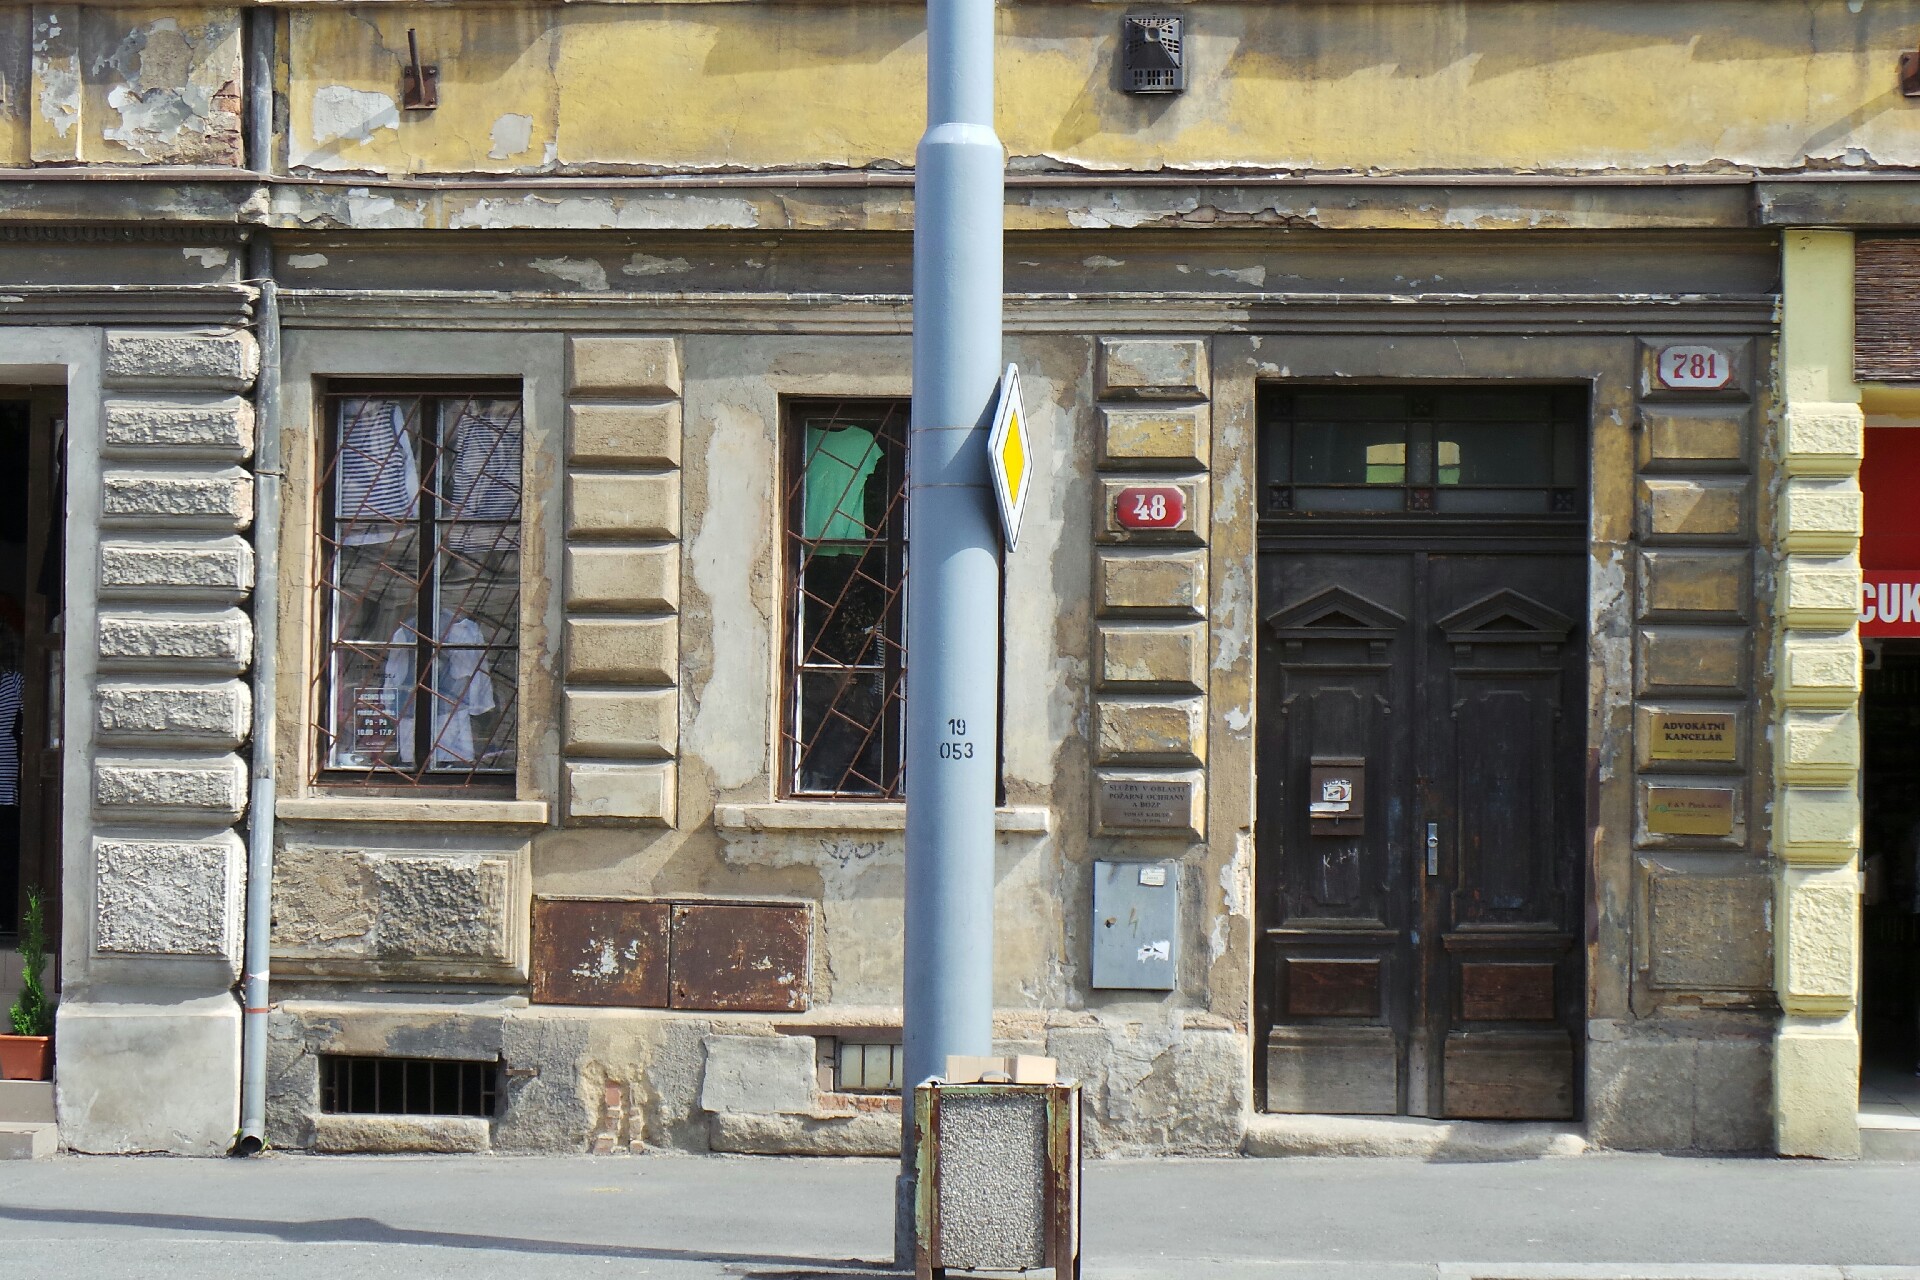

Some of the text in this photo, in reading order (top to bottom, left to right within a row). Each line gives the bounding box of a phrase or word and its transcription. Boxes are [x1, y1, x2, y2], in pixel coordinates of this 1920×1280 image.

[1673, 353, 1717, 379] 781
[1133, 494, 1167, 521] 48
[948, 718, 966, 736] 19
[1663, 721, 1726, 731] ADVOKÁTNÍ
[1665, 732, 1723, 741] KANCELÁŘ
[940, 742, 974, 760] 053
[1150, 785, 1185, 793] OBLASTI
